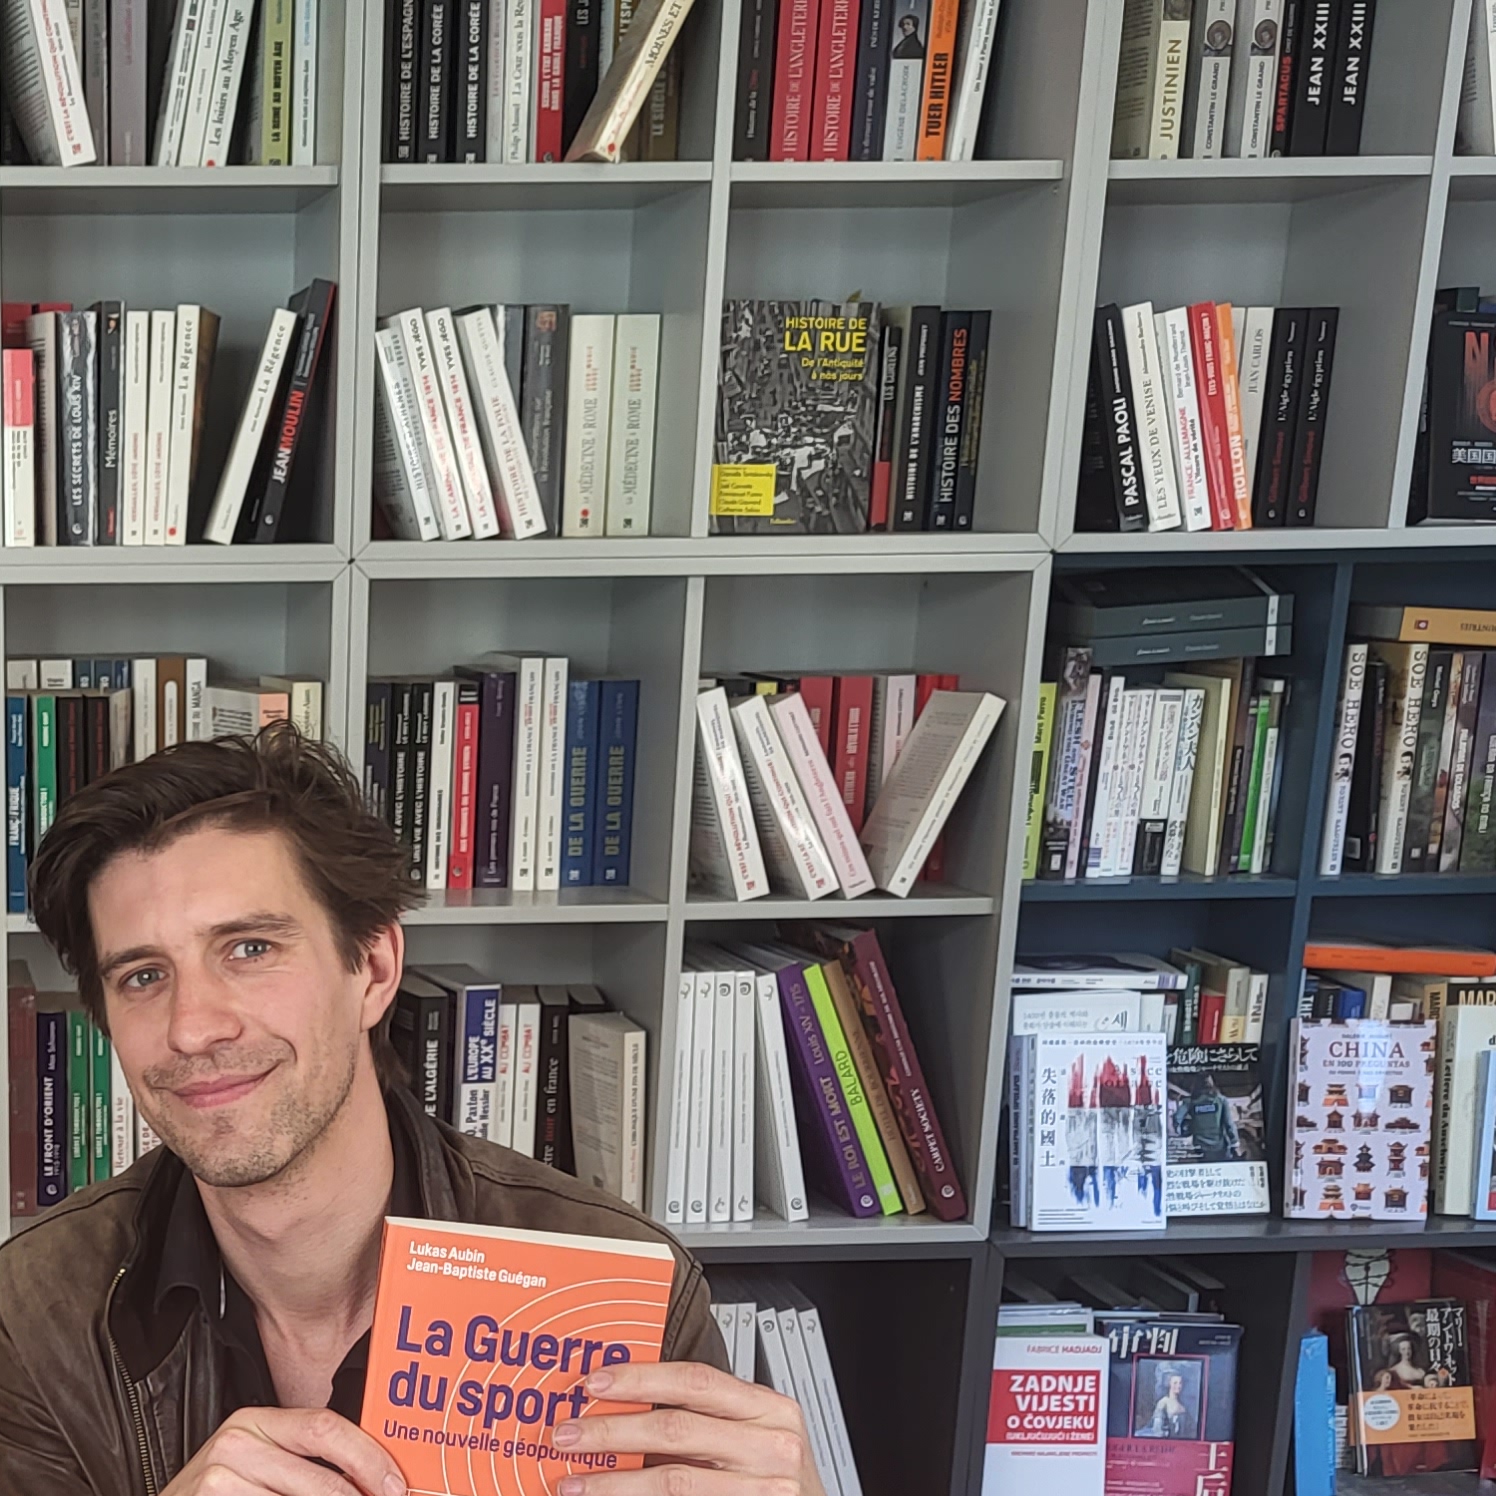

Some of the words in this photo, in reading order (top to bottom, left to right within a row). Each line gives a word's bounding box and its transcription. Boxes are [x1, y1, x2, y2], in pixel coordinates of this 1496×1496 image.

[1349, 2, 1366, 50] XXIII
[929, 52, 948, 99] HITLER
[1160, 39, 1181, 140] JUSTINIEN
[1343, 57, 1360, 105] JEAN
[925, 103, 943, 138] TUER
[785, 317, 846, 330] HISTOIRE
[849, 318, 867, 330] DE
[784, 331, 812, 350] LA
[820, 331, 866, 352] RUE
[802, 357, 813, 367] De
[816, 357, 864, 368] l'Antiquité
[822, 372, 836, 380] nos
[840, 372, 863, 380] jours
[949, 328, 967, 401] NOMBRES
[69, 374, 81, 391] XIV
[70, 394, 82, 423] LOUIS
[946, 404, 960, 433] DES
[1143, 379, 1156, 425] VENISE
[70, 426, 81, 439] DE
[1113, 397, 1130, 442] PAOLI
[104, 410, 117, 468] Mémoires
[1148, 428, 1159, 446] DE
[70, 442, 82, 485] SECRETS
[940, 437, 958, 502] HISTOIRE
[1120, 447, 1140, 506] PASCAL
[1152, 449, 1164, 484] YEUX
[1231, 435, 1247, 499] ROLLON
[71, 487, 82, 505] LES
[1155, 487, 1168, 509] LES
[1348, 652, 1367, 692] SOE
[1342, 699, 1360, 749] HERO
[569, 747, 587, 806] GUERRE
[569, 813, 585, 830] LA
[569, 837, 583, 856] DE
[789, 983, 806, 1007] 1715
[482, 999, 497, 1036] SIÈCLE
[798, 1015, 815, 1033] XIV
[466, 1036, 480, 1081] L'EUROPE
[807, 1034, 825, 1065] Louis
[1322, 1060, 1335, 1068] EN
[1357, 1059, 1410, 1069] PREGUNTAS
[1329, 1041, 1404, 1058] CHINA
[482, 1066, 494, 1080] AU
[835, 1050, 862, 1106] BALARD
[43, 1077, 54, 1126] D'ORIENT
[820, 1076, 842, 1116] MORT
[910, 1087, 932, 1132] SOCIETY
[835, 1119, 850, 1141] EST
[1040, 1067, 1057, 1169] 失落的國土
[44, 1128, 54, 1162] FRONT
[842, 1144, 860, 1170] ROI
[927, 1133, 945, 1172] CARPET
[43, 1164, 54, 1176] LE
[853, 1173, 866, 1188] LE
[409, 1241, 447, 1259] Lukas
[448, 1247, 485, 1264] Aubin
[407, 1258, 496, 1282] Jean-Baptiste
[498, 1269, 547, 1288] Guégan
[396, 1305, 454, 1357] La
[464, 1315, 631, 1375] Guerre
[1026, 1344, 1060, 1355] FABRICE
[1062, 1344, 1102, 1355] HADJADJ
[1426, 1308, 1441, 1371] 最期の日々
[1440, 1308, 1457, 1386] アントワネット
[388, 1362, 448, 1412] du
[457, 1378, 589, 1429] sport
[1010, 1375, 1096, 1394] ZADNJE
[1016, 1394, 1096, 1412] VIJESTI
[383, 1419, 419, 1442] Une
[423, 1428, 501, 1453] nouvelle
[1007, 1415, 1020, 1429] O
[1024, 1411, 1095, 1430] ČOVJEKU
